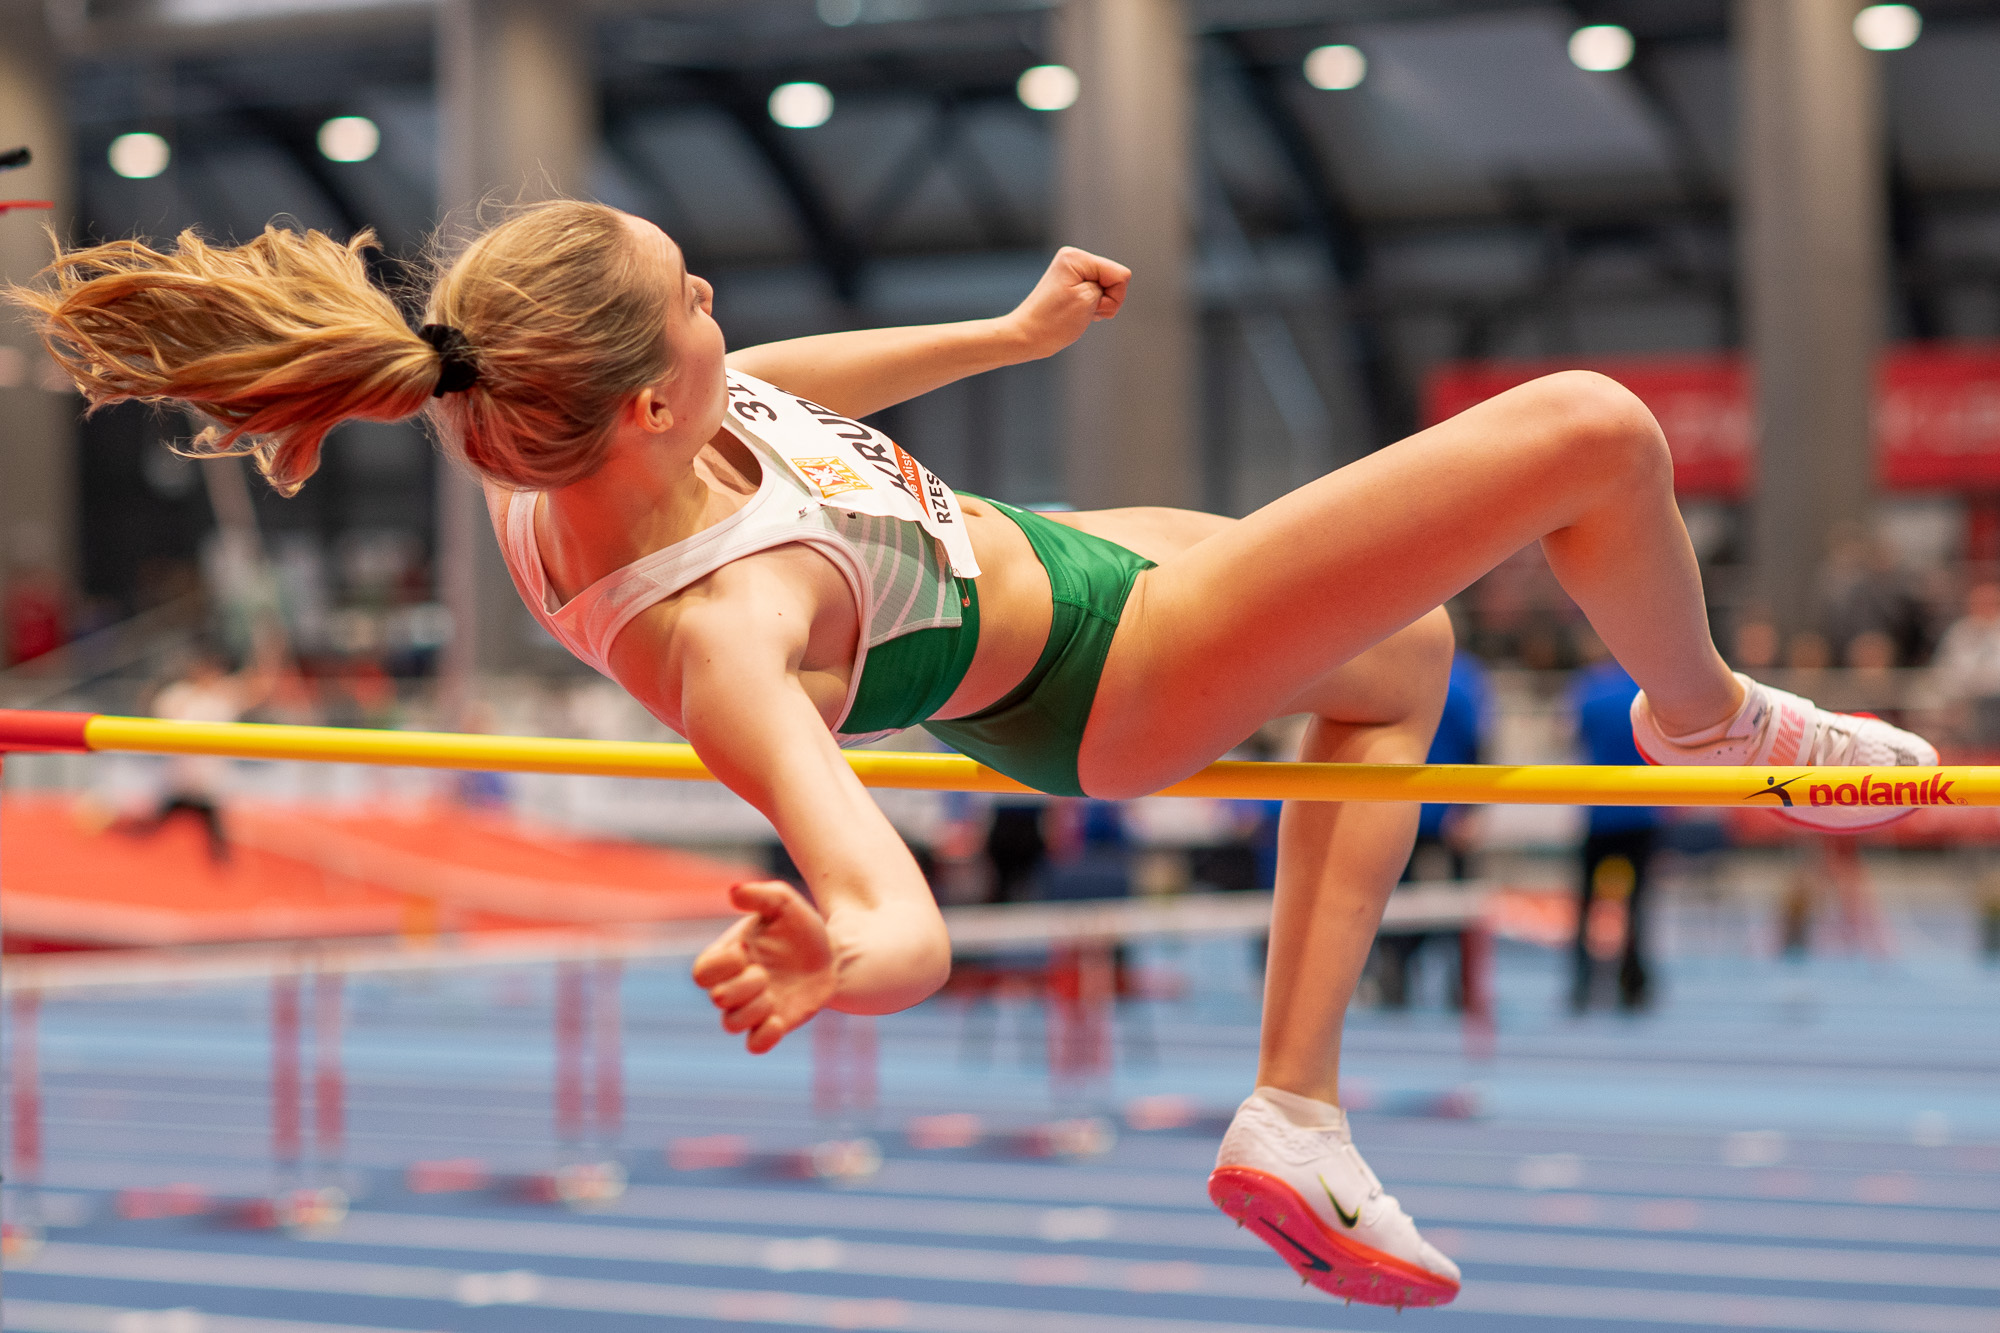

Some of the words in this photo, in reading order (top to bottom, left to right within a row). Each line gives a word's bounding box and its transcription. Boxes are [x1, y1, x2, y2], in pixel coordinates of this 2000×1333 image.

[727, 375, 777, 422] 31
[774, 387, 919, 502] KRUP
[899, 447, 917, 482] Mistr
[828, 458, 869, 488] PZLA
[922, 466, 953, 524] RZES
[1809, 772, 1956, 807] polanik
